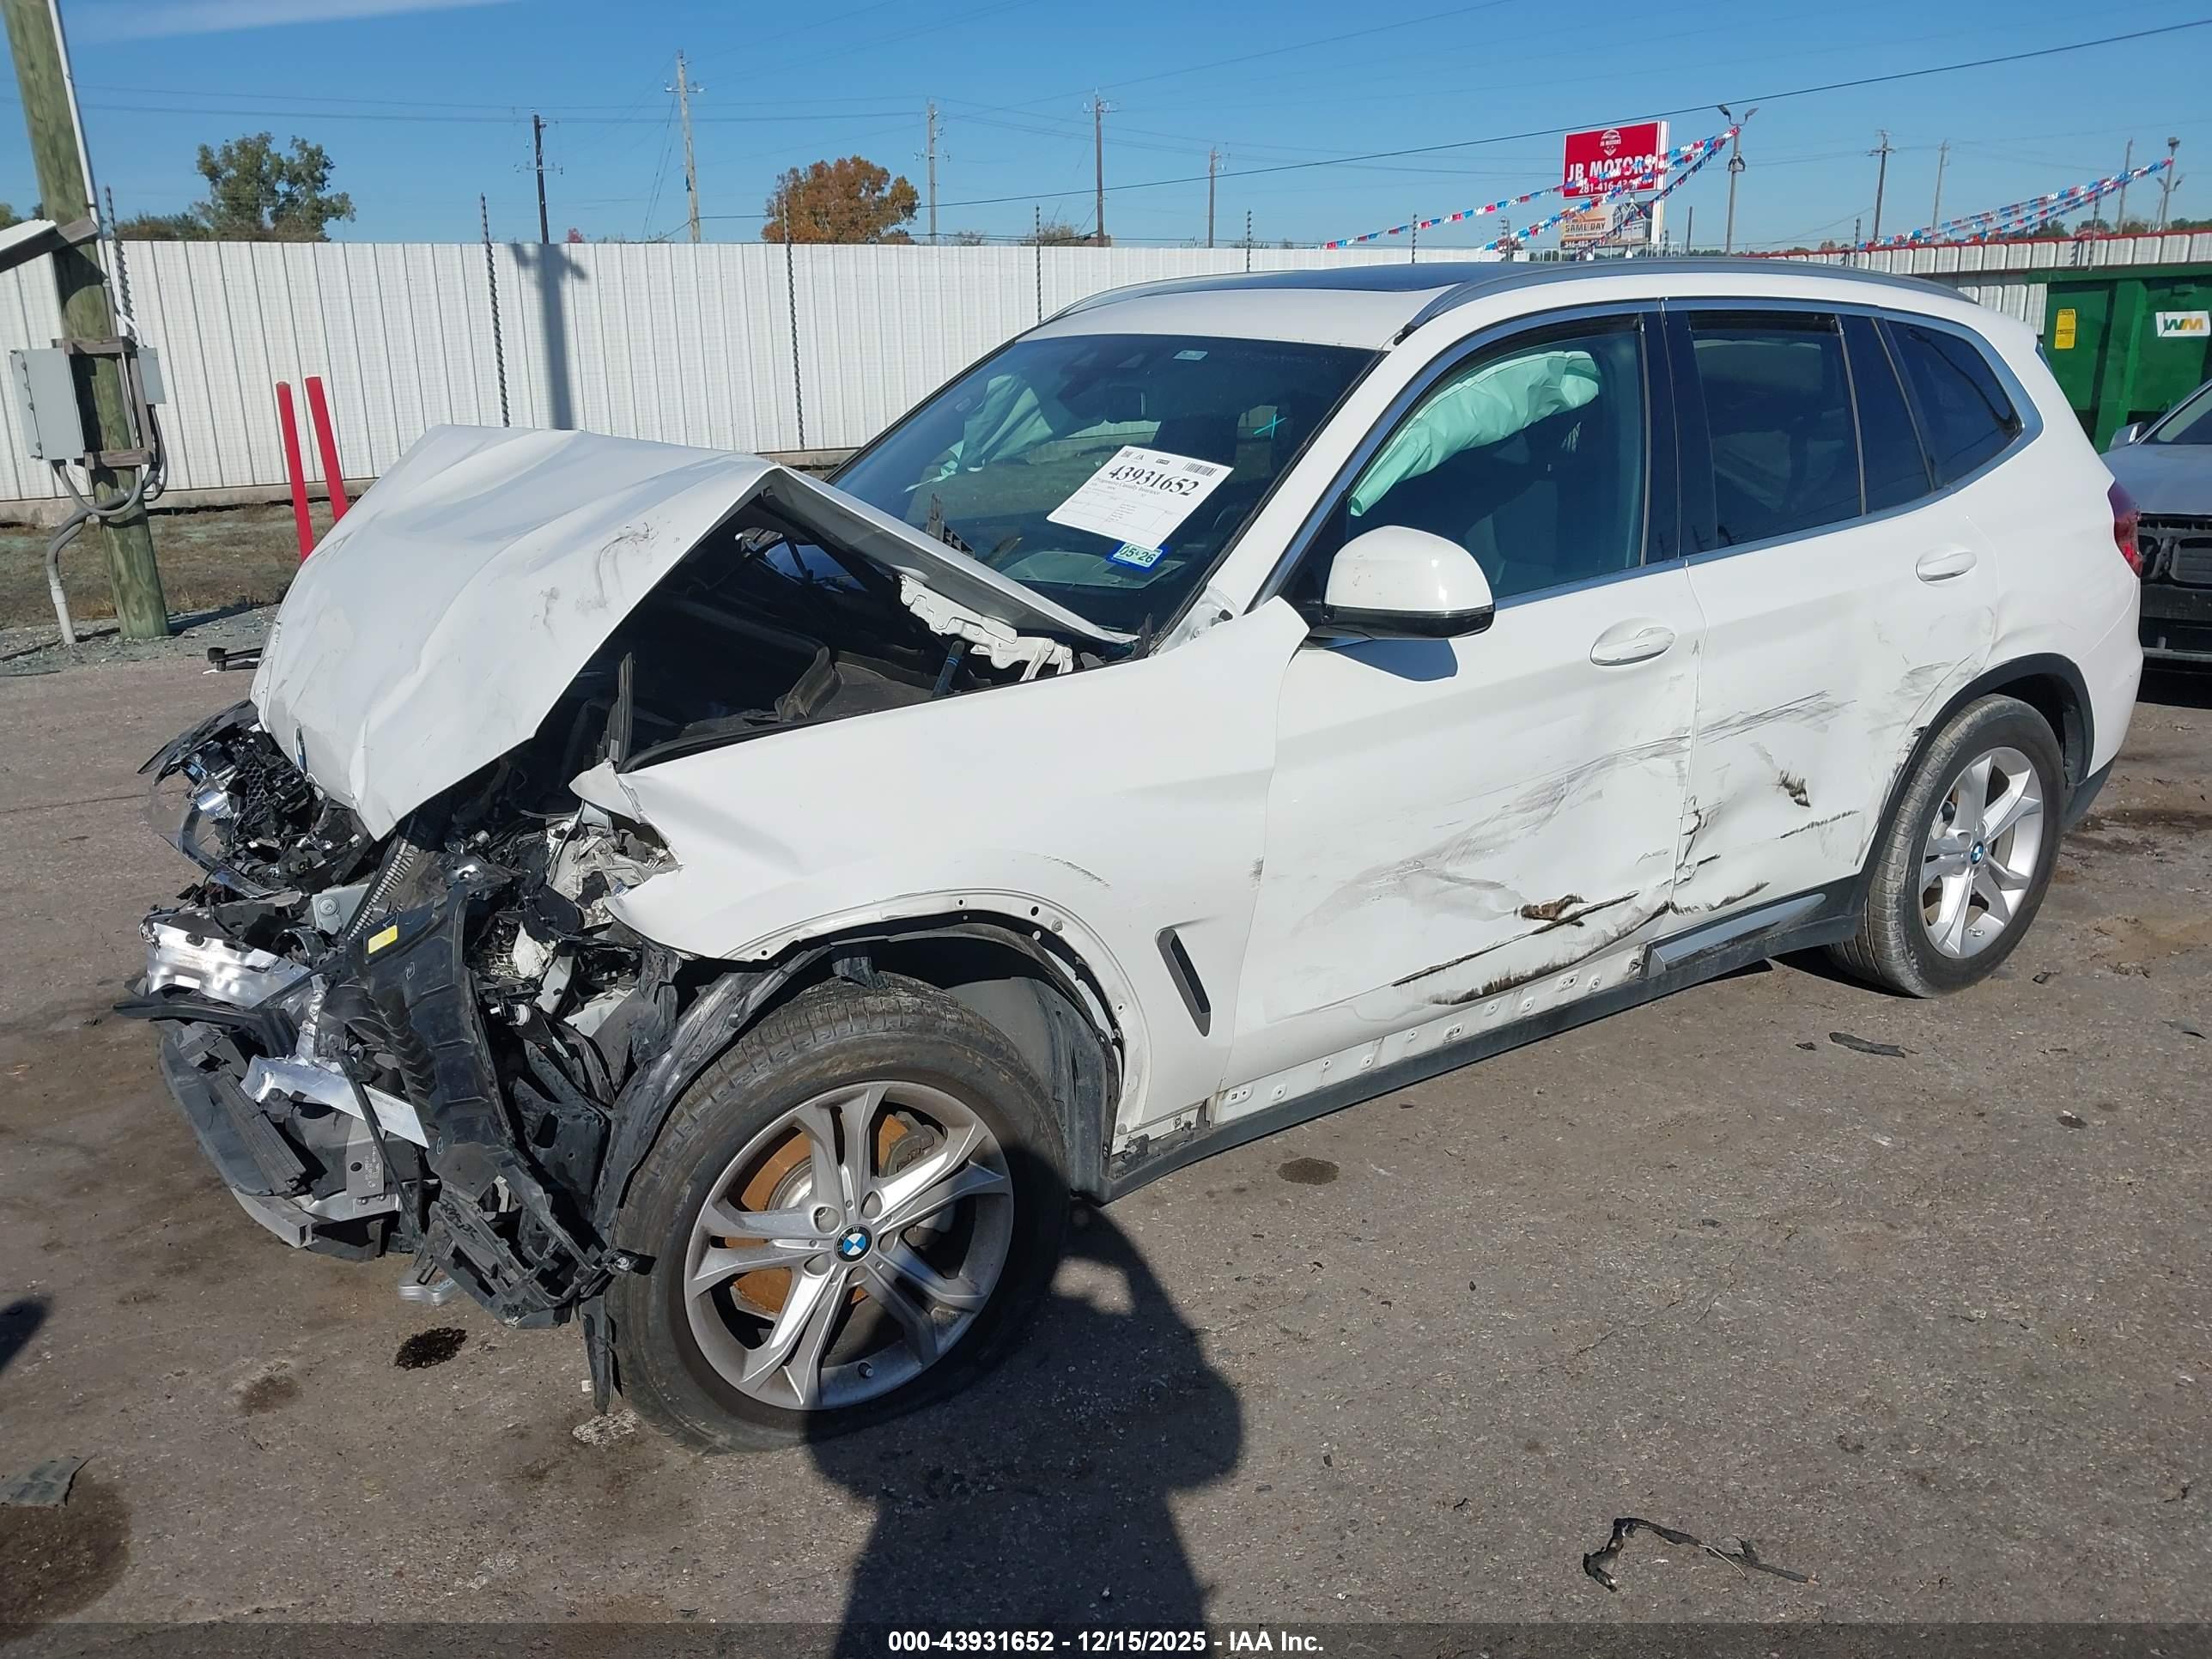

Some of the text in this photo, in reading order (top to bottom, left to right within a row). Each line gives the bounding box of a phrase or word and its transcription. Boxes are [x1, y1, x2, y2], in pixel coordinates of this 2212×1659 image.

[1567, 154, 1653, 183] JB MOTORS
[1578, 179, 1638, 194] 281-416-4
[1565, 222, 1606, 232] SAME DAY
[2165, 318, 2204, 331] WM
[1109, 465, 1200, 496] 43931652
[1137, 551, 1157, 563] 26
